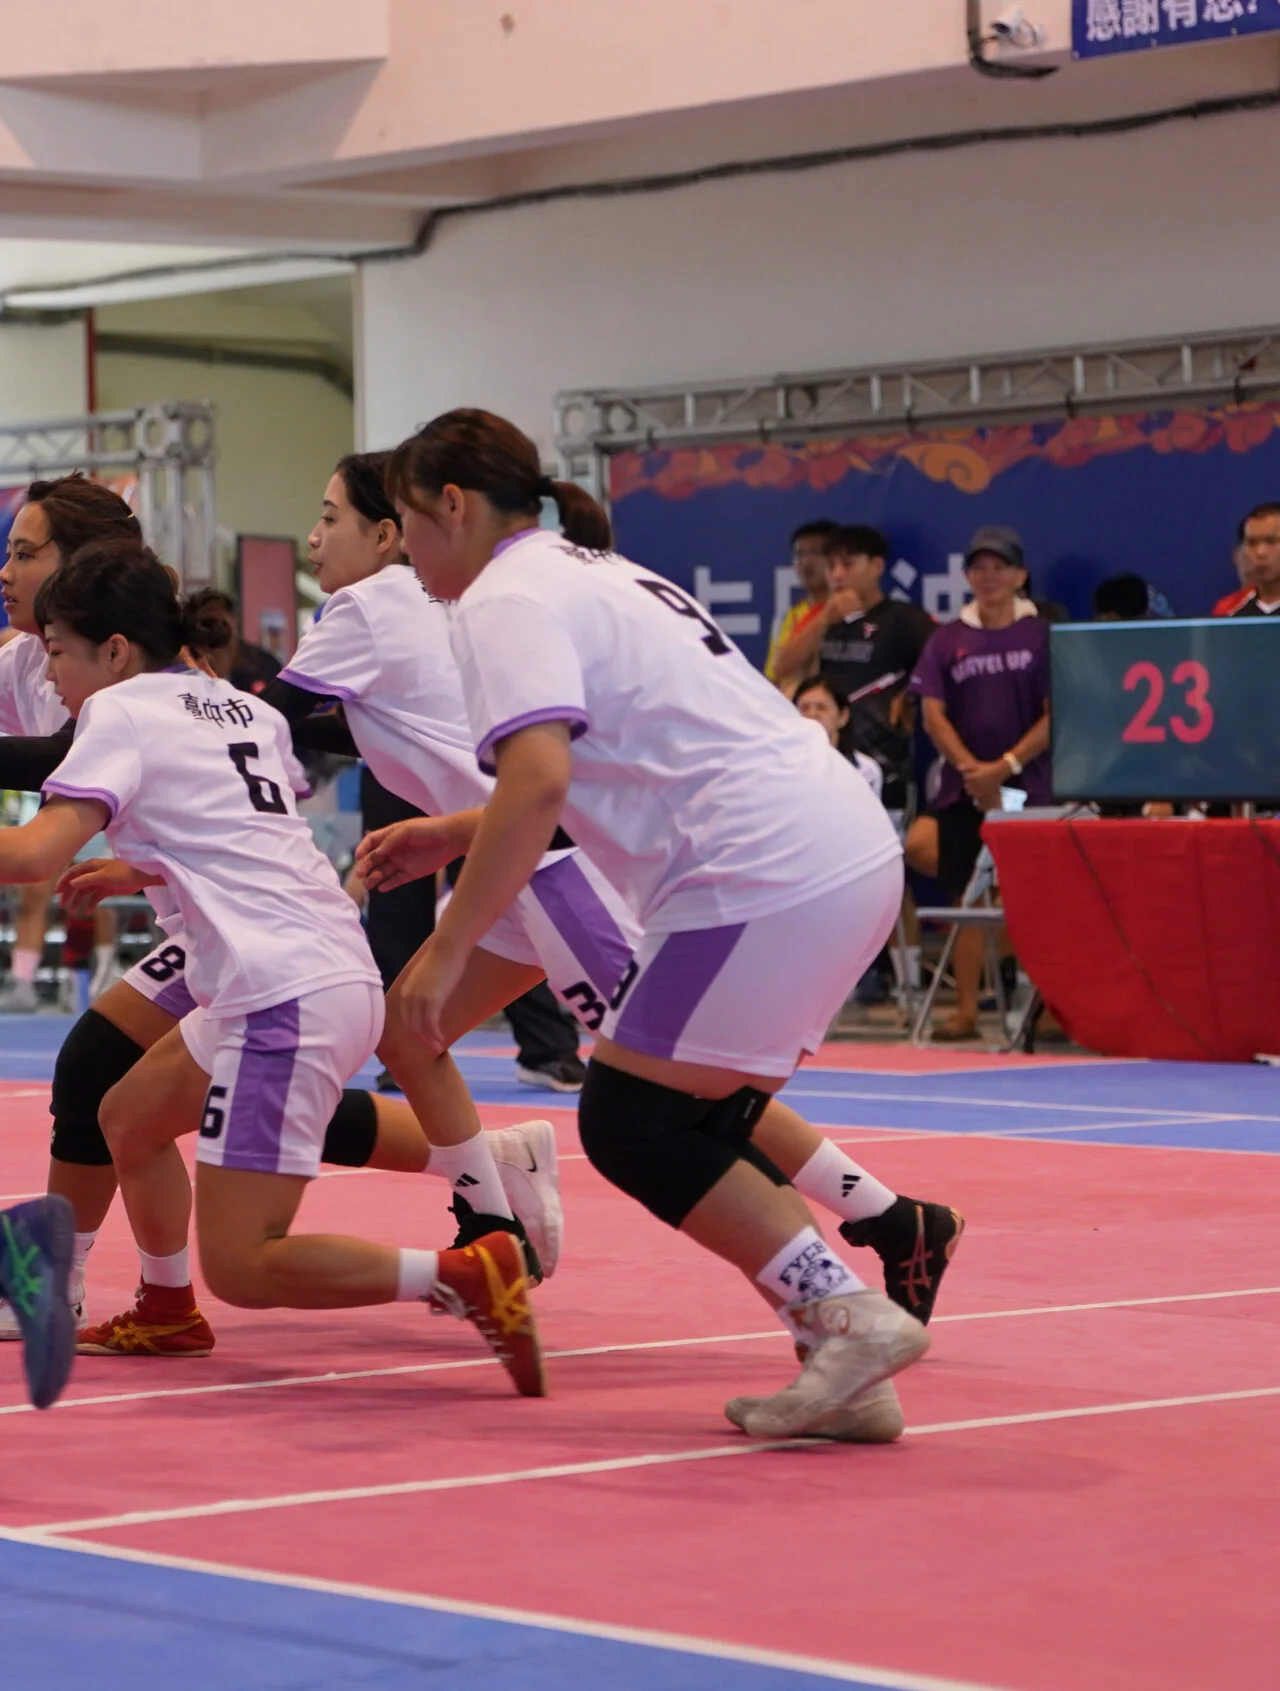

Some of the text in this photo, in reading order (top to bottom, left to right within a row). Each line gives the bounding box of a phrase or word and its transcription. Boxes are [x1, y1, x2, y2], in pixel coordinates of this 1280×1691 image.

[634, 579, 733, 656] 9
[177, 692, 254, 729] 臺中市
[1122, 660, 1214, 744] 23
[227, 742, 288, 815] 6
[140, 945, 186, 982] 8
[561, 980, 607, 1031] 3
[200, 1085, 228, 1138] 6
